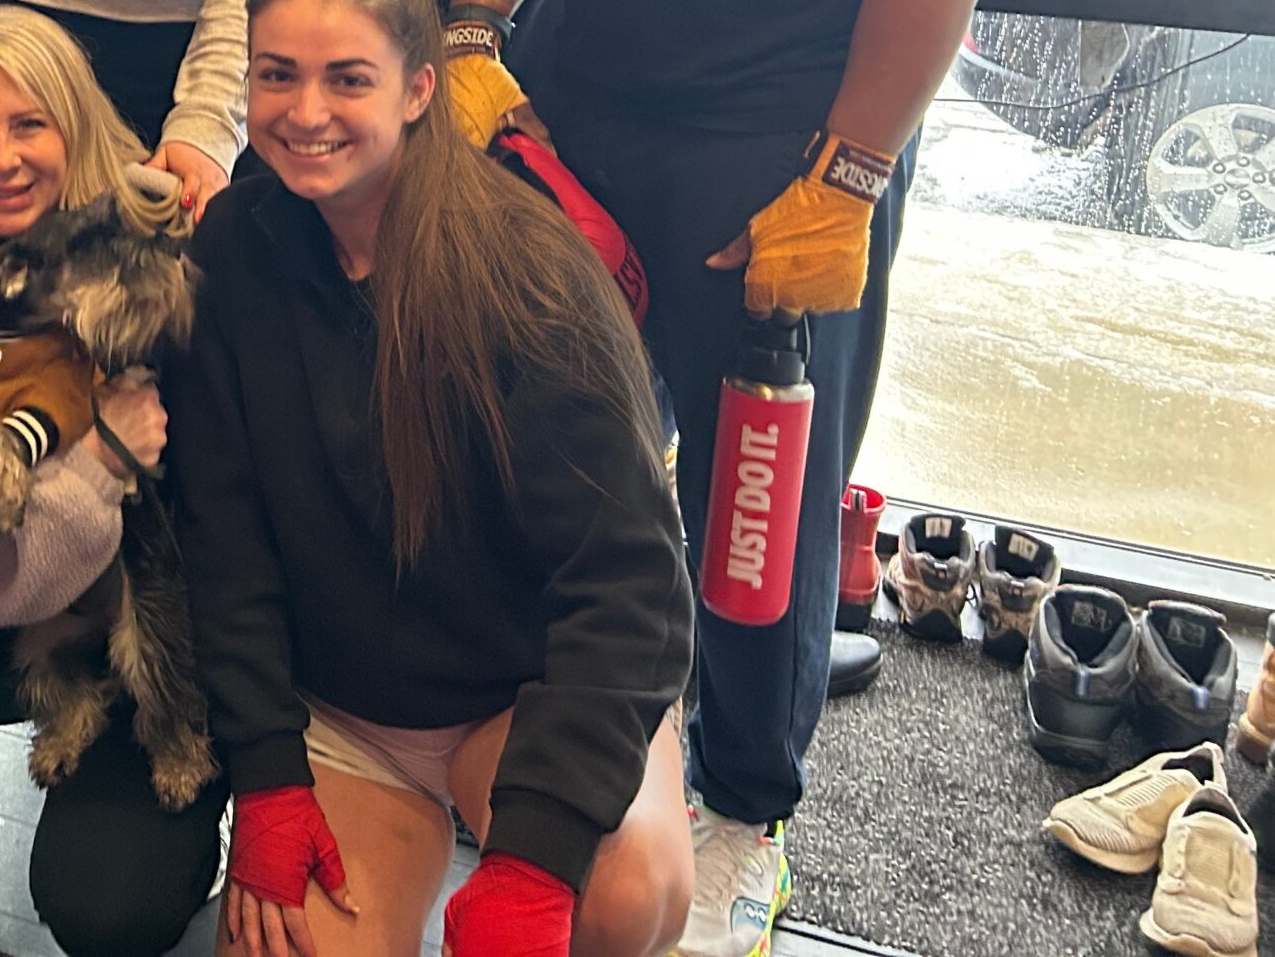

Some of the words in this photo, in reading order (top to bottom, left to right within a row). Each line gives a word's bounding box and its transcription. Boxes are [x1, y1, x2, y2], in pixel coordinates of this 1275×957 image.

[444, 27, 494, 46] NGSIDE
[831, 156, 888, 198] NGSIDE
[740, 423, 779, 462] IT.
[735, 462, 775, 513] DO
[727, 511, 767, 589] JUST
